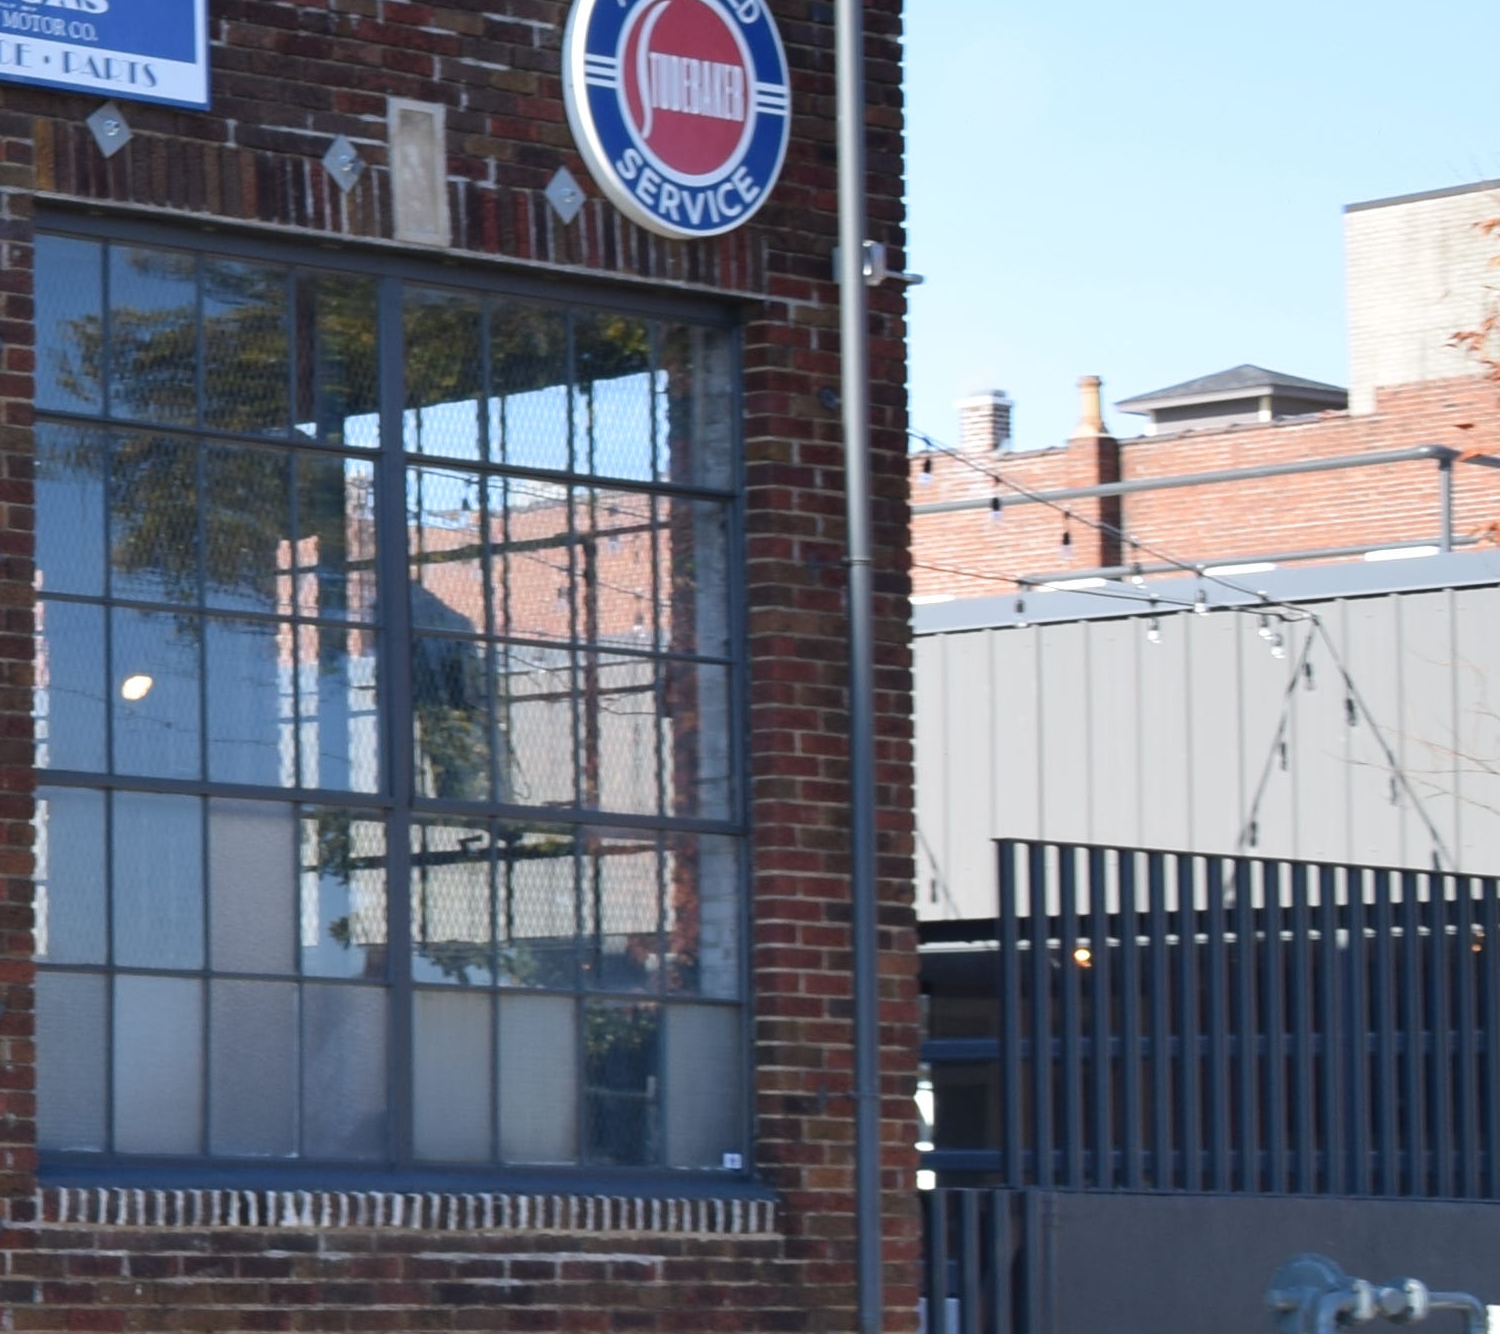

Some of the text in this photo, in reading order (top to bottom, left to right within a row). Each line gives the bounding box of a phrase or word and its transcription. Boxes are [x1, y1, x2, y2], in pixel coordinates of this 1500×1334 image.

[2, 9, 68, 40] MOTOR
[62, 49, 159, 90] PARTS
[615, 147, 762, 226] SERVICE
